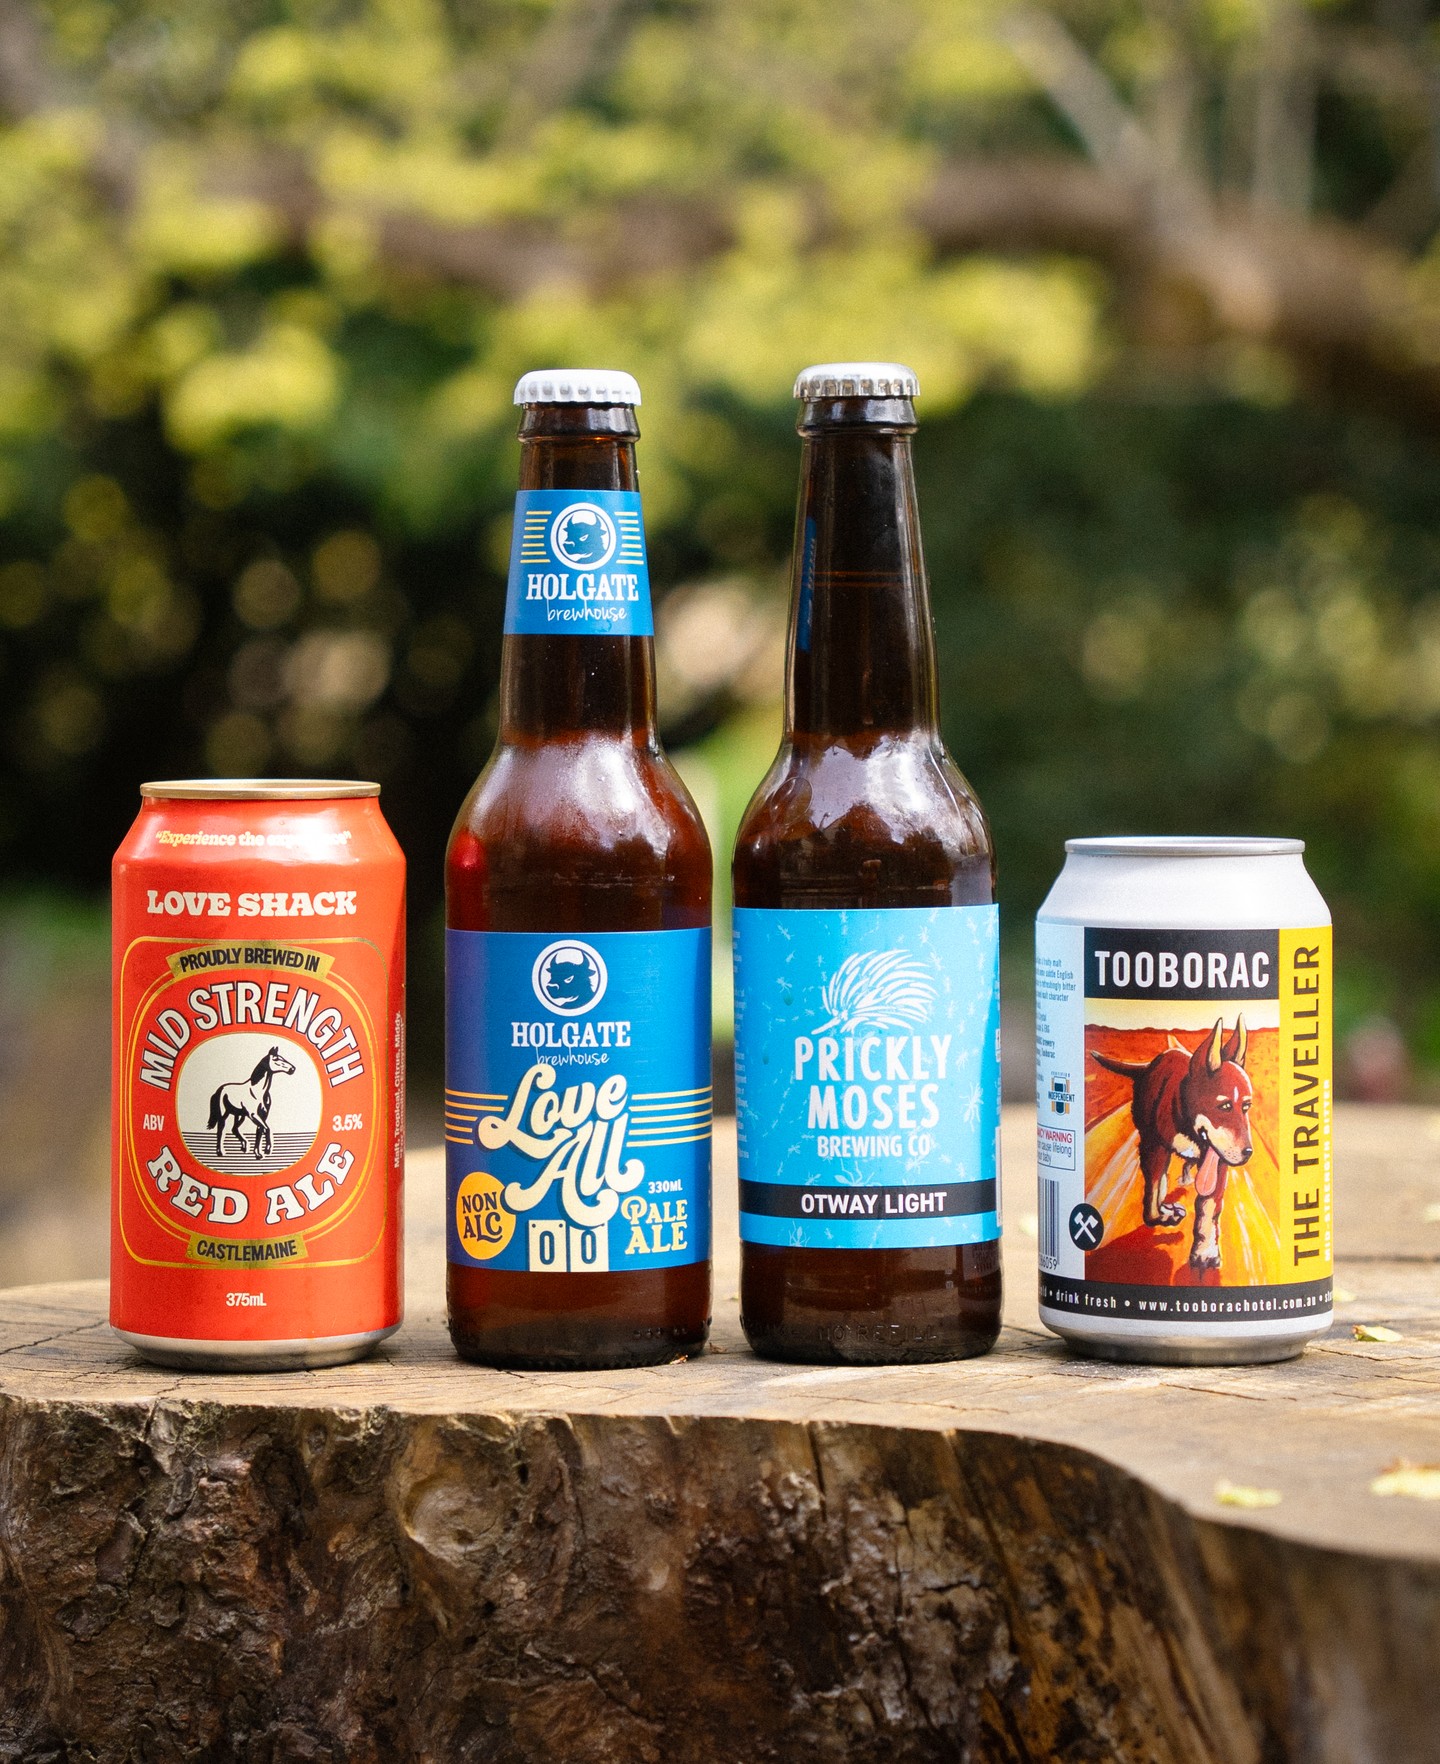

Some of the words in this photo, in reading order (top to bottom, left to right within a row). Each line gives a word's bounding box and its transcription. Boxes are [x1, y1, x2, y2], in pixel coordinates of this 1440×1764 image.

[526, 573, 639, 601] HOLGATE
[546, 599, 628, 622] brewhouse
[239, 831, 265, 846] the
[147, 890, 231, 916] LOVE
[238, 891, 357, 917] SHACK
[180, 948, 242, 973] PROUDLY
[245, 947, 304, 968] BREWED
[305, 957, 320, 972] IN
[1094, 950, 1270, 989] TOOBORAC
[1057, 970, 1073, 980] English
[1062, 982, 1076, 991] bitter
[140, 1008, 192, 1090] MID
[188, 980, 365, 1088] STRENGTH
[511, 1020, 631, 1048] HOLGATE
[535, 1046, 609, 1066] brewhouse
[794, 1034, 953, 1082] PRICKLY
[1293, 944, 1320, 1174] TRAVELLER
[807, 1083, 940, 1130] MOSES
[1048, 1091, 1075, 1102] INDEPENDENT
[1323, 1079, 1331, 1135] BITTER
[143, 1114, 165, 1131] ABV
[332, 1114, 363, 1131] 3.5%
[478, 1063, 628, 1159] Love
[817, 1135, 902, 1158] BREWING
[908, 1135, 930, 1156] CO
[1045, 1130, 1073, 1143] WARNING
[1053, 1142, 1072, 1158] lifelong
[504, 1112, 645, 1228] All
[147, 1145, 249, 1225] RED
[265, 1142, 355, 1225] ALE
[648, 1179, 683, 1195] 330ML
[461, 1191, 497, 1214] NON
[621, 1195, 688, 1225] PALE
[801, 1193, 878, 1215] OTWAY
[885, 1192, 948, 1214] LIGHT
[1323, 1141, 1331, 1262] MID-STRENGTH
[463, 1211, 504, 1243] ALC
[625, 1222, 688, 1255] ALE
[1293, 1189, 1320, 1266] THE
[196, 1239, 298, 1261] CASTLEMAINE
[226, 1293, 267, 1307] 375mL
[1056, 1289, 1079, 1304] drink
[1084, 1293, 1117, 1308] fresh
[1139, 1296, 1316, 1313] www.tooborachotel.com.au
[818, 1325, 846, 1342] NO
[857, 1324, 938, 1342] REFILL
